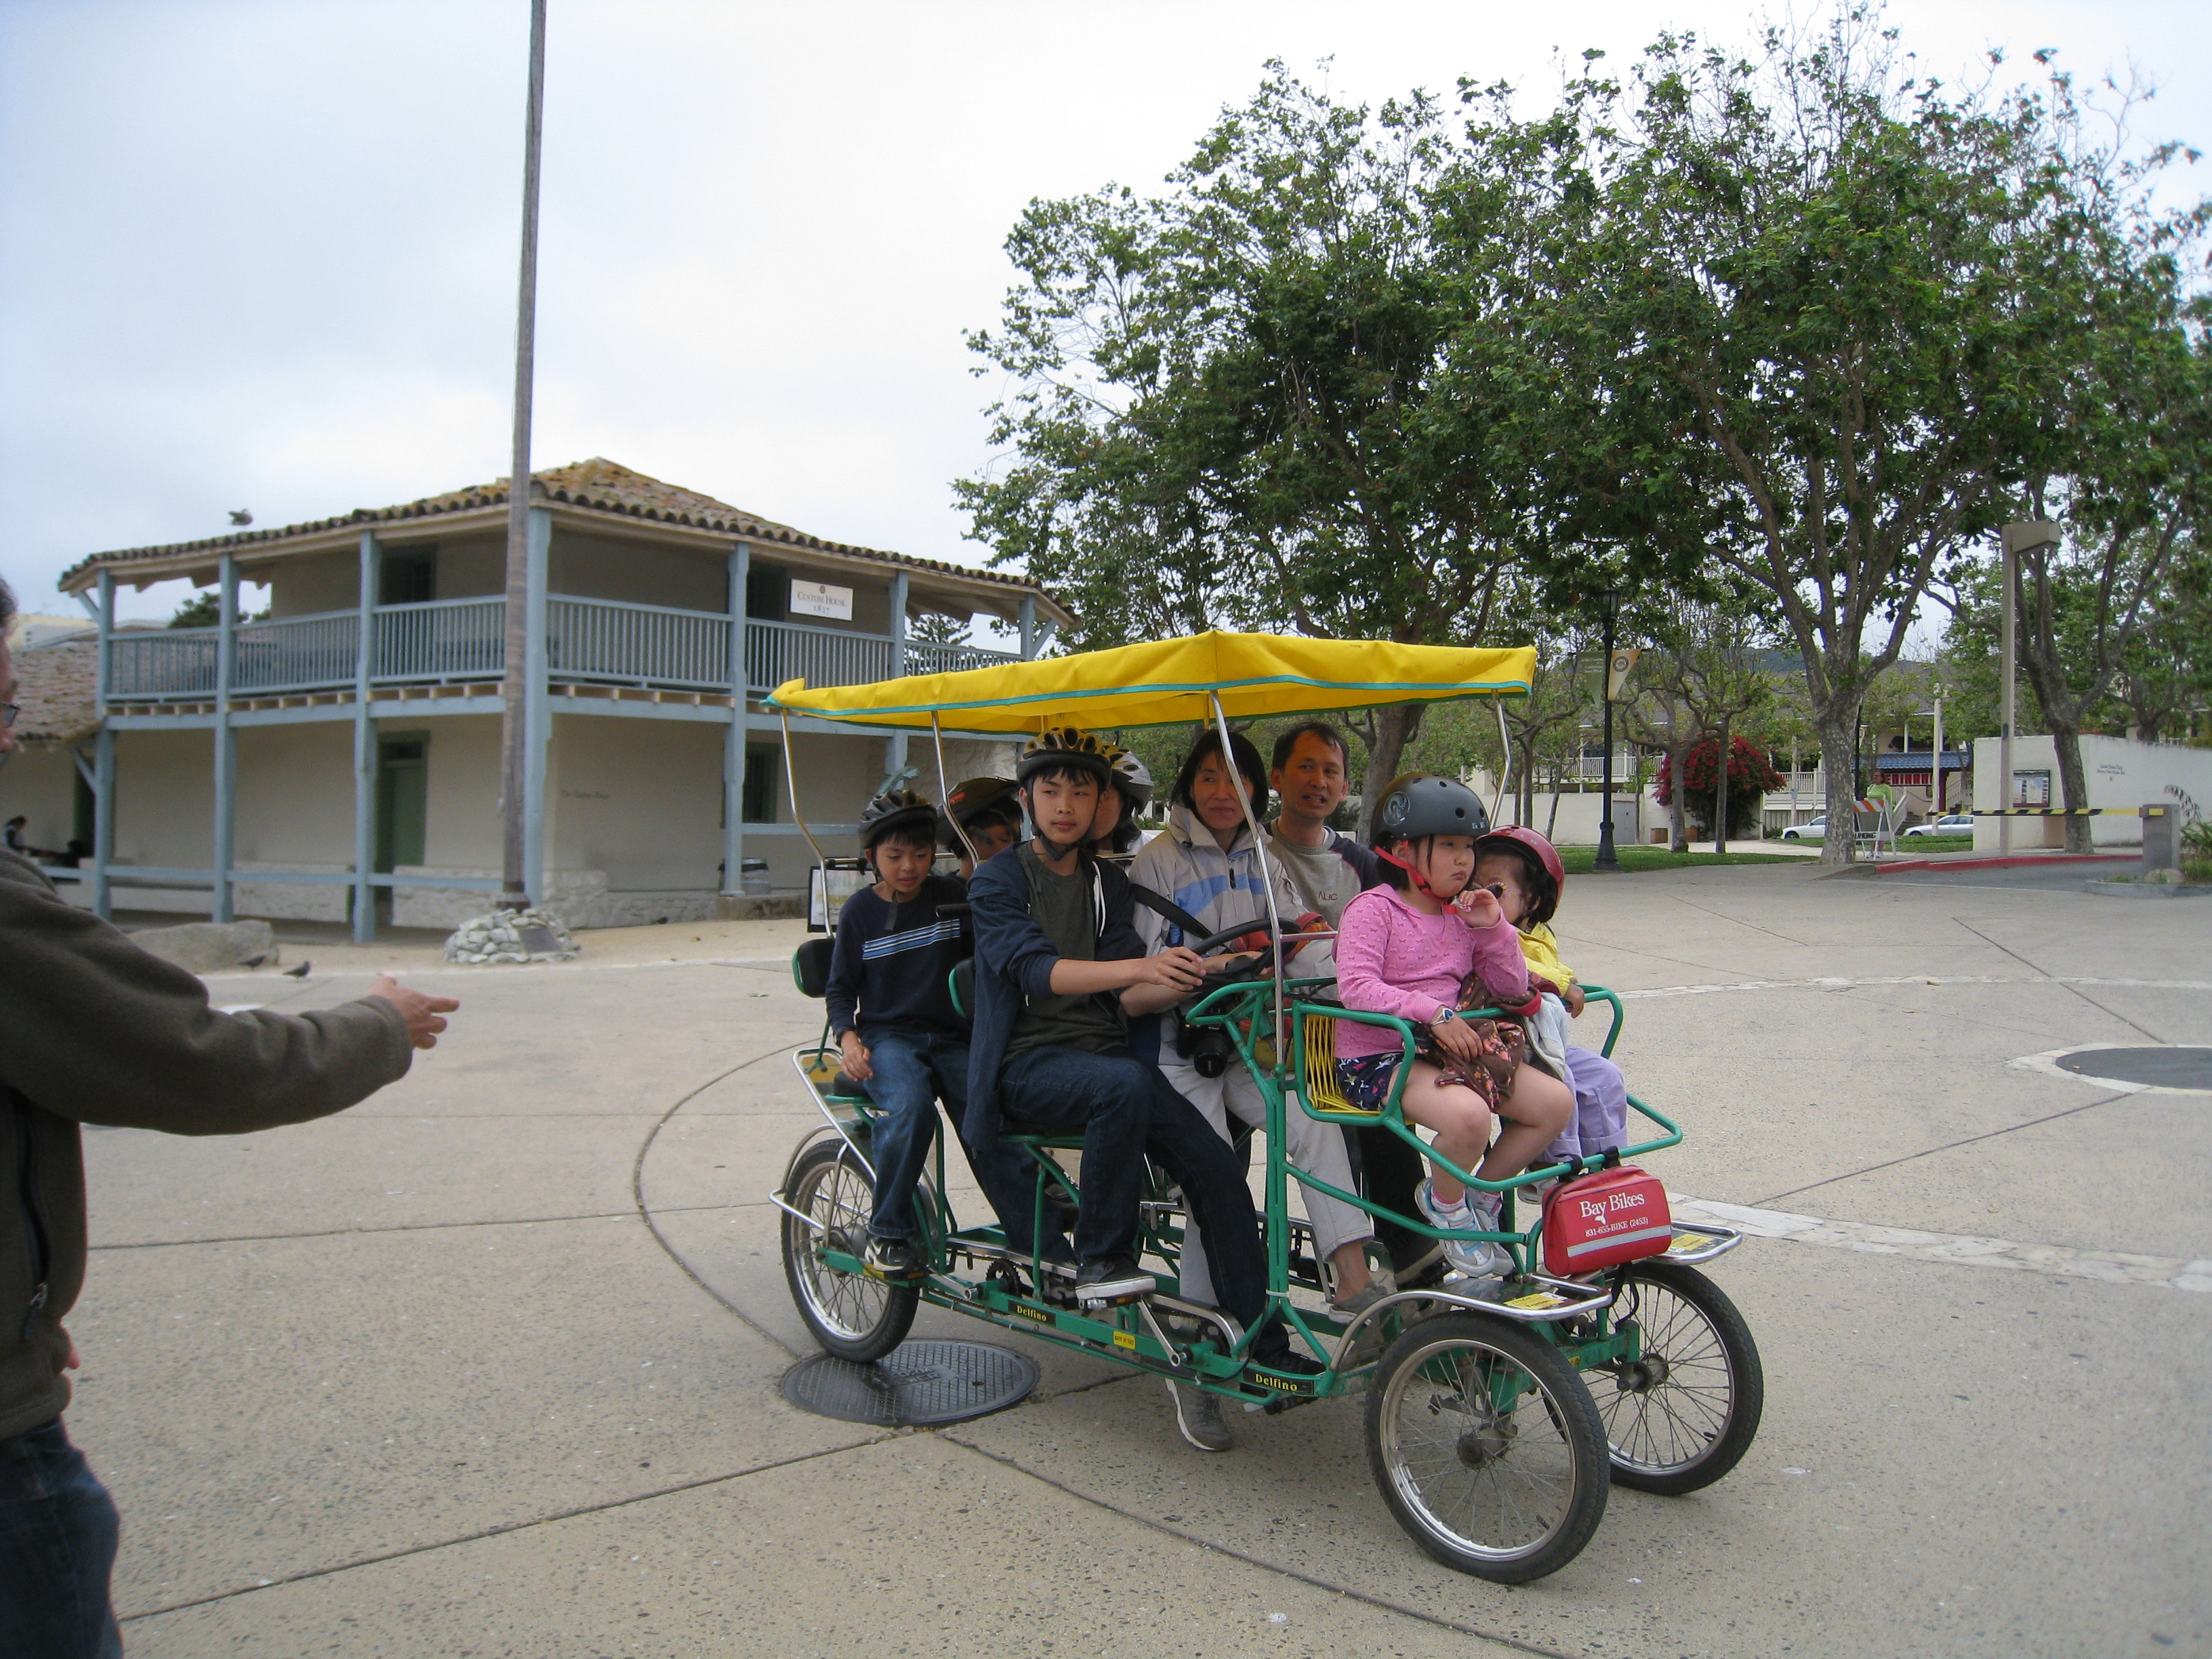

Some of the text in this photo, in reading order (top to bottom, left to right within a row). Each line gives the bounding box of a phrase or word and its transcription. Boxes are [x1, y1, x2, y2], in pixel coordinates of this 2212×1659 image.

[1579, 1192, 1645, 1218] Bay Bikes
[1584, 1216, 1649, 1237] 831-655-BIKE (2453)
[1017, 1305, 1047, 1322] Delfino
[1254, 1373, 1298, 1391] Delfino
